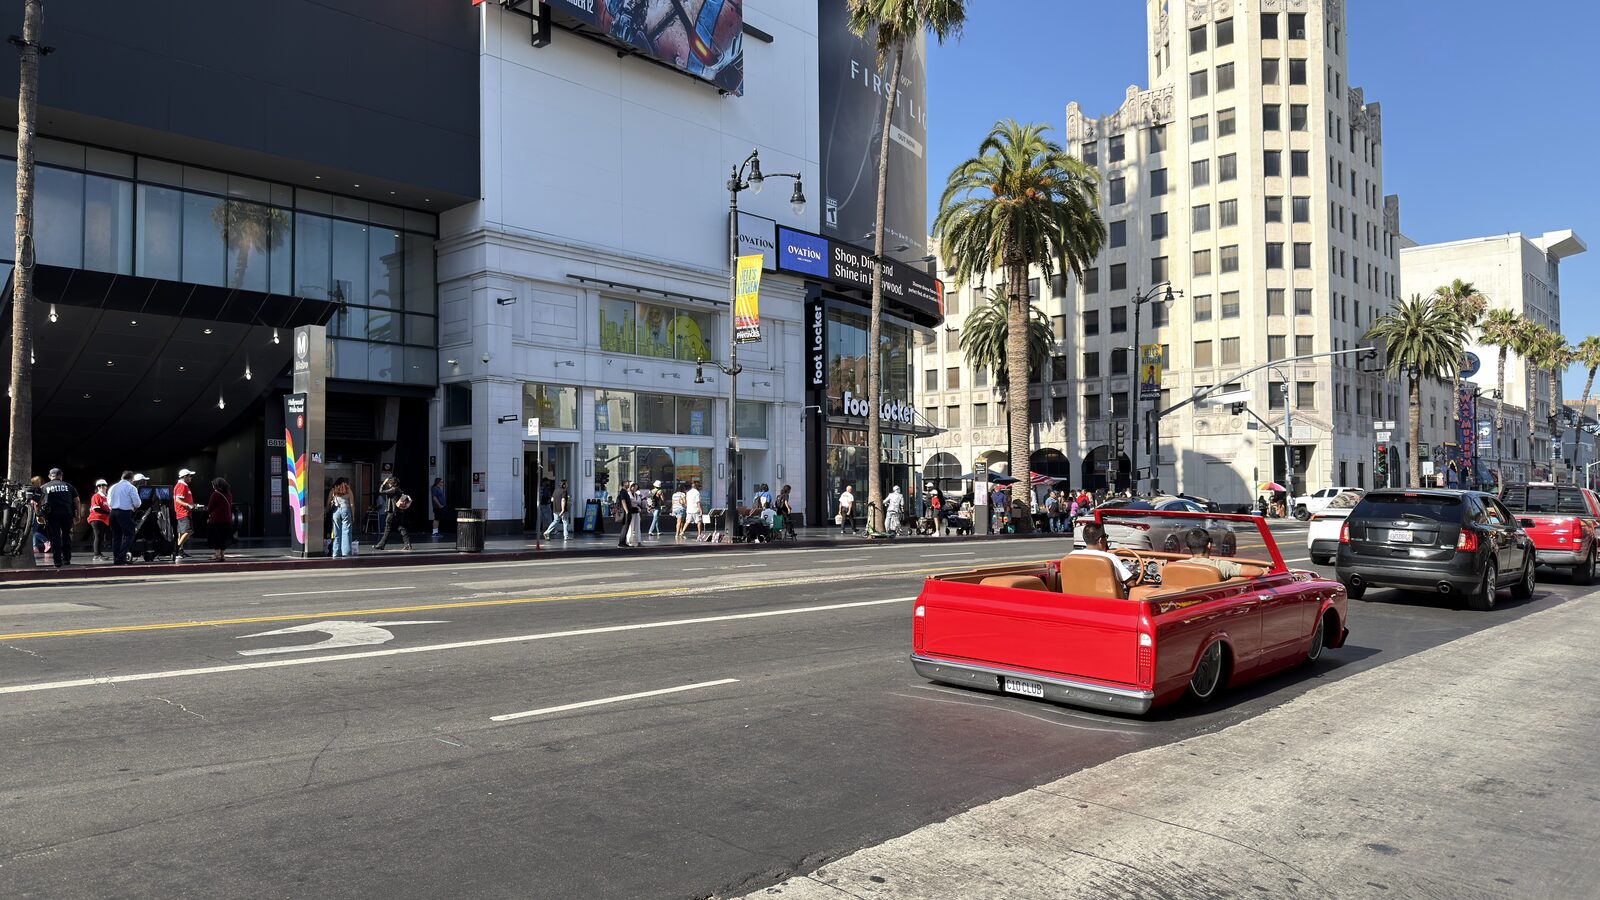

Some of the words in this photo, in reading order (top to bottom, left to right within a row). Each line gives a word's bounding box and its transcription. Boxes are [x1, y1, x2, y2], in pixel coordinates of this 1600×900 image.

[851, 59, 902, 108] FIRST
[897, 133, 906, 143] OUT
[906, 138, 915, 149] NOW
[828, 208, 836, 223] T
[739, 234, 774, 249] OVATION
[788, 245, 821, 260] OVATION
[834, 247, 860, 268] Shop,
[861, 254, 875, 270] Din
[835, 264, 859, 281] Shine
[859, 270, 868, 282] in
[813, 305, 823, 351] Locker
[813, 354, 823, 385] Foot
[844, 391, 870, 417] Foo
[1461, 394, 1471, 417] WAX
[1460, 420, 1472, 467] MUSEUM
[46, 485, 69, 494] POLICE
[1006, 679, 1021, 691] C10
[1022, 682, 1042, 695] CLUB
